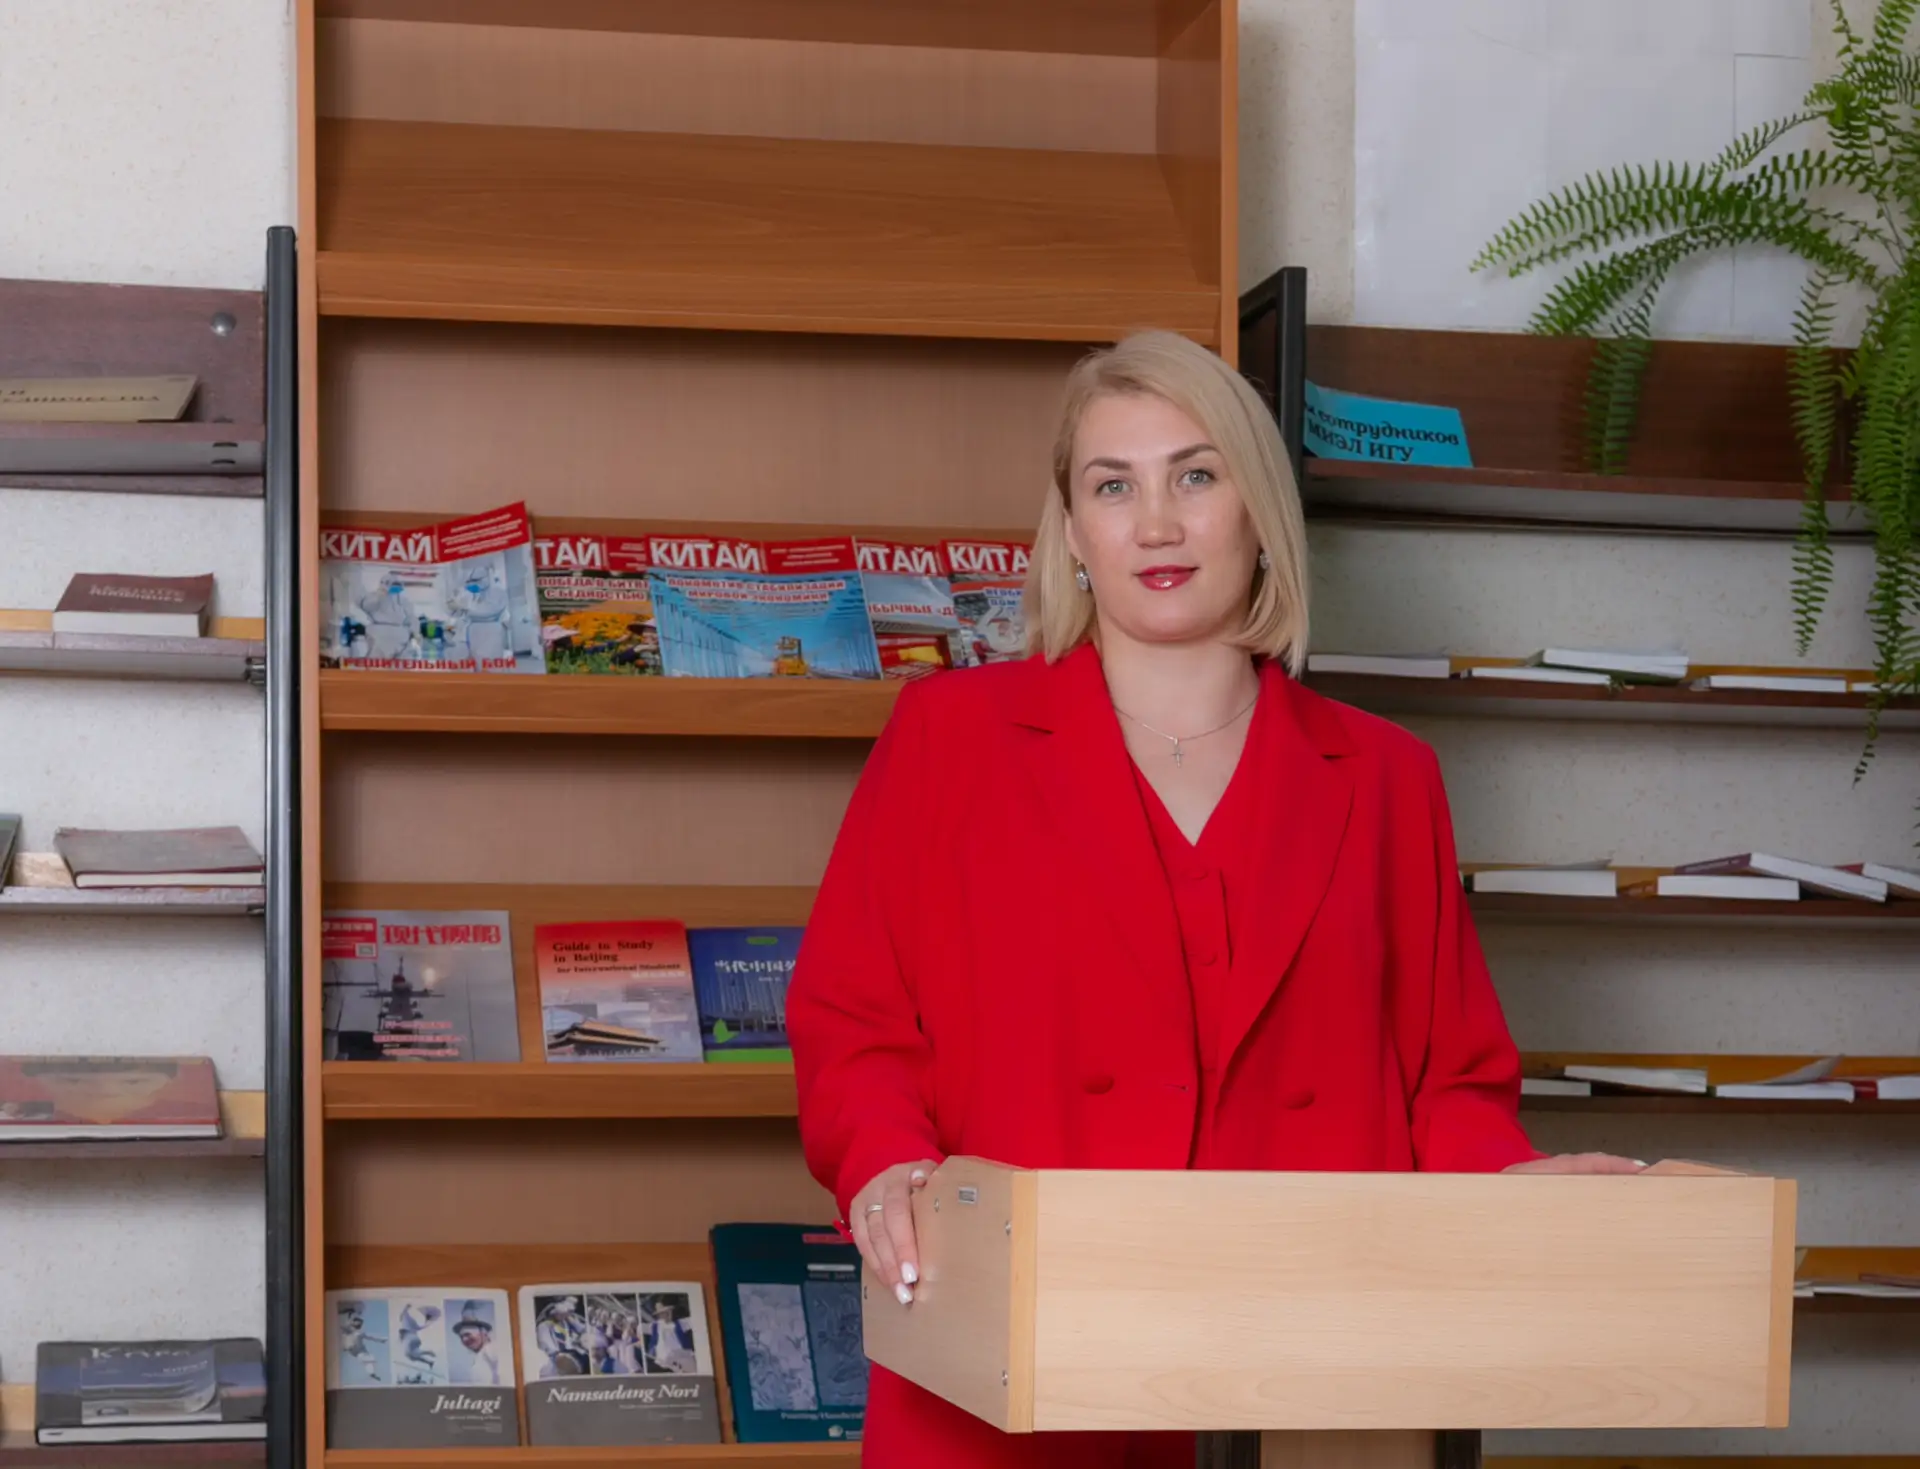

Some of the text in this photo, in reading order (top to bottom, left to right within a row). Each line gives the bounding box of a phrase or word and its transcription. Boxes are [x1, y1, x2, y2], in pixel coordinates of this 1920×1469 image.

[1369, 442, 1415, 463] ИГУ
[320, 532, 432, 562] КИТАЙ
[649, 541, 760, 572] КИТАЙ
[538, 576, 594, 588] ПОБЕДА
[596, 577, 605, 588] В
[546, 588, 645, 601] С БЕДНОСТЬЮ
[343, 655, 517, 670] РЕШИТЕЛЬНЫЙ БОЙ
[552, 939, 654, 953] Guide to Study
[553, 951, 619, 964] in Beijing
[573, 964, 637, 973] International
[639, 962, 681, 971] Students
[546, 1382, 701, 1404] Namsadang Nori
[430, 1393, 502, 1415] Jultagi
